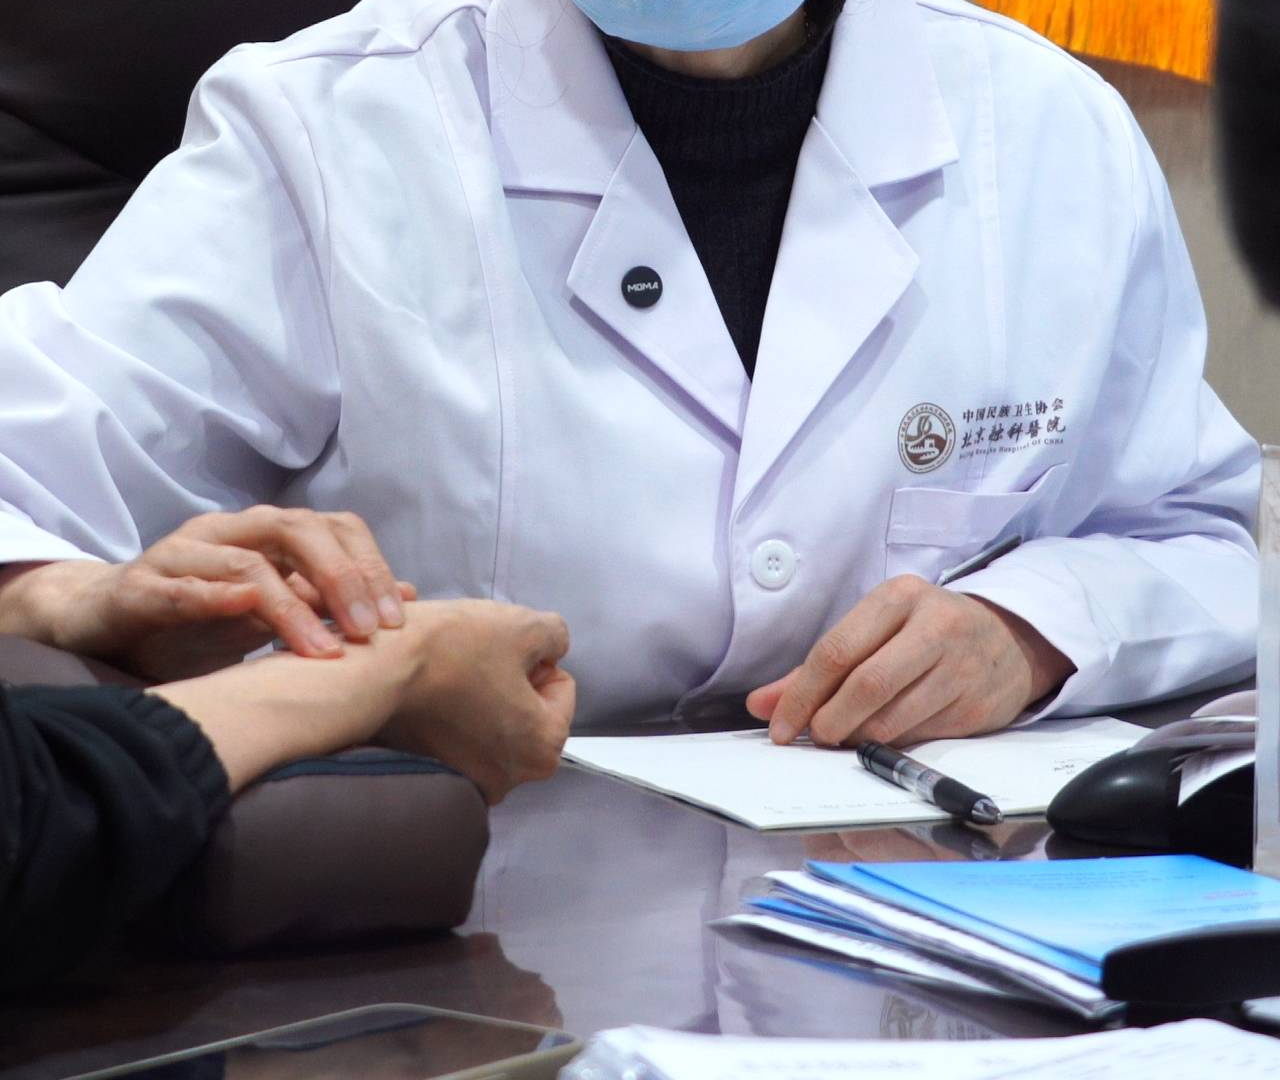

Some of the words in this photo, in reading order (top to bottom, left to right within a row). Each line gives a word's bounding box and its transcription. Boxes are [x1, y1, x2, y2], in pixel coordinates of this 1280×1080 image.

[962, 397, 1064, 424] 中国民族卫生协会
